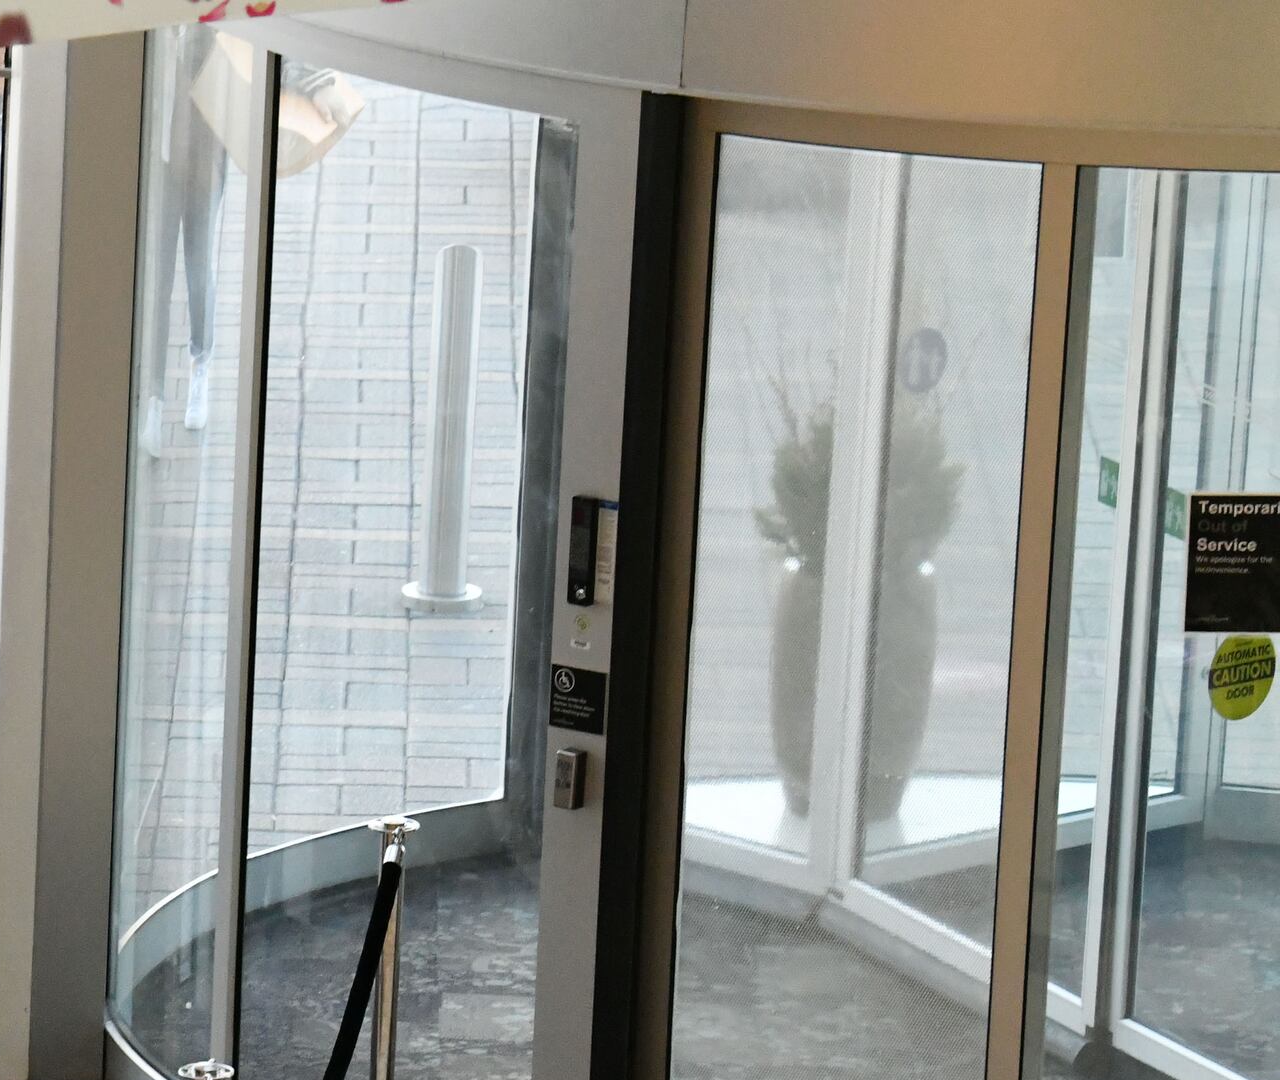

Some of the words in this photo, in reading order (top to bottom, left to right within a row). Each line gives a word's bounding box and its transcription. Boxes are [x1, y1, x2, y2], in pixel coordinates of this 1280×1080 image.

[1198, 519, 1226, 533] Out
[1232, 519, 1248, 533] of
[1197, 537, 1258, 552] Service
[1216, 644, 1271, 664] AUTOMATIC
[1213, 660, 1272, 687] CAUTION
[1226, 685, 1255, 700] DOOR
